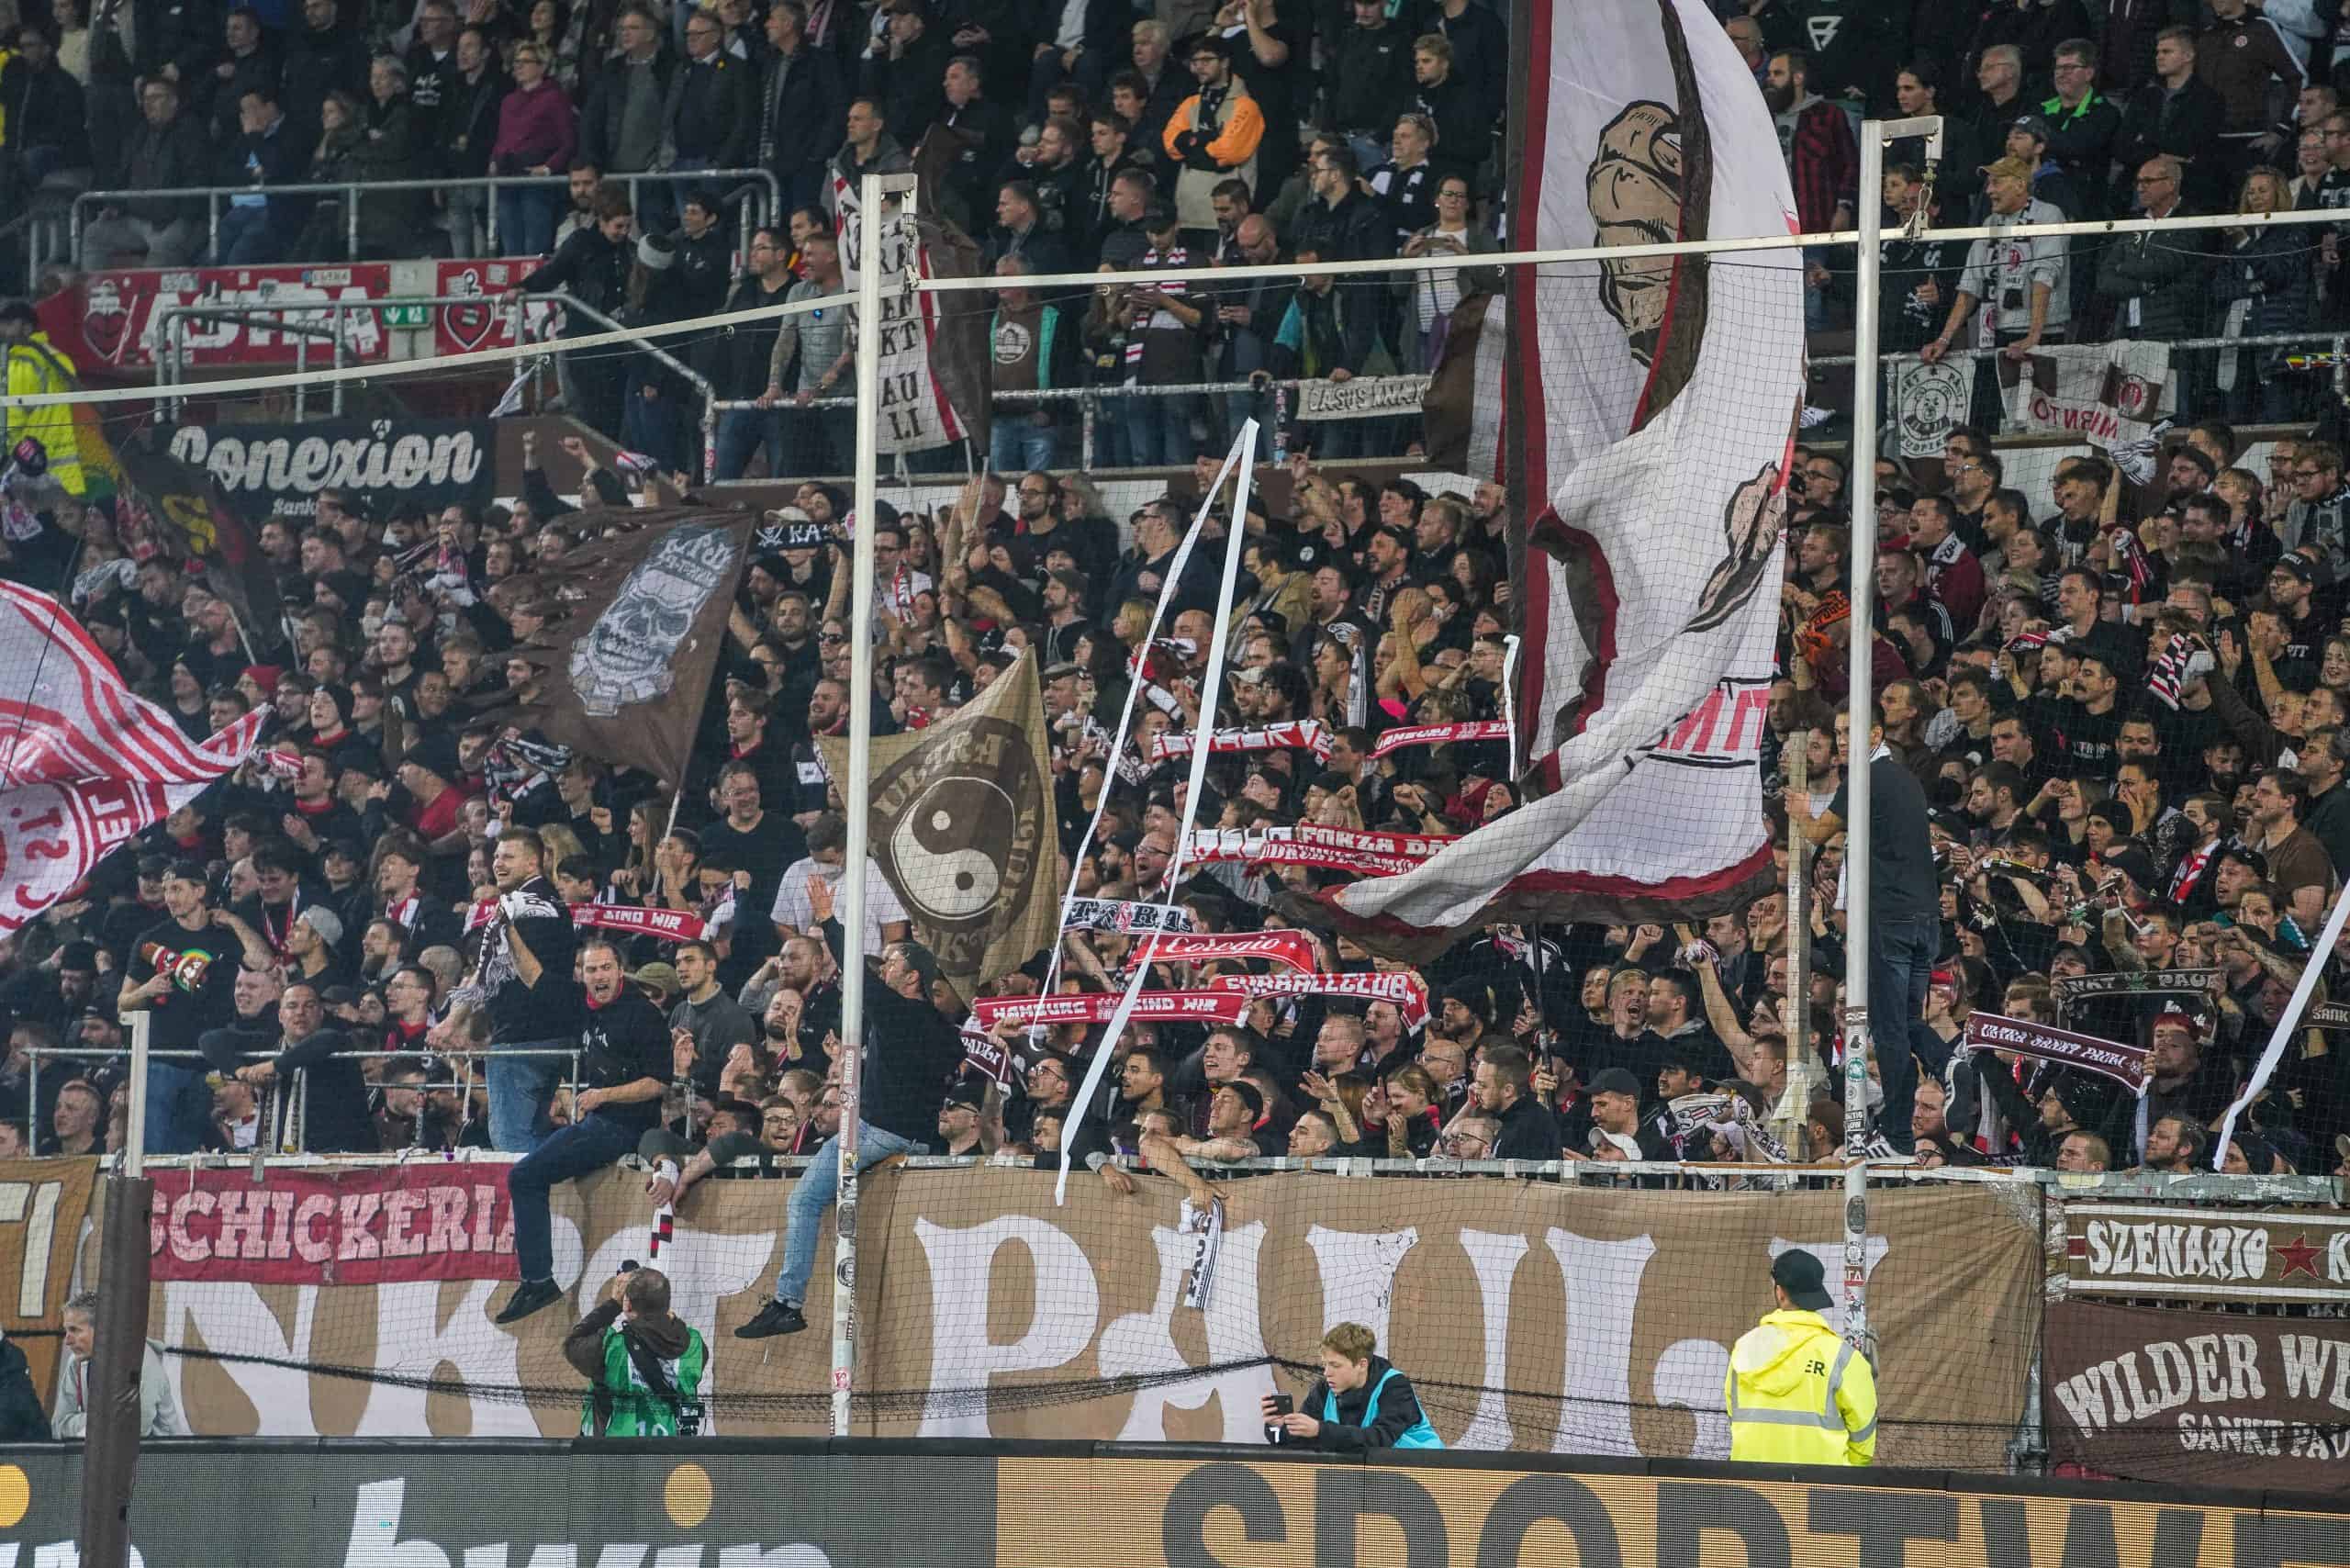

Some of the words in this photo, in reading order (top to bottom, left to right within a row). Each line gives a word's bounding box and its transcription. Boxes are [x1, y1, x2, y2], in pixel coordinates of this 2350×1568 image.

[992, 999, 1088, 1019] HAMBURG
[1182, 997, 1218, 1013] WIR
[2086, 1219, 2270, 1282] SZENARIO
[2053, 1333, 2267, 1439] WILDER
[2178, 1413, 2285, 1458] SANKT
